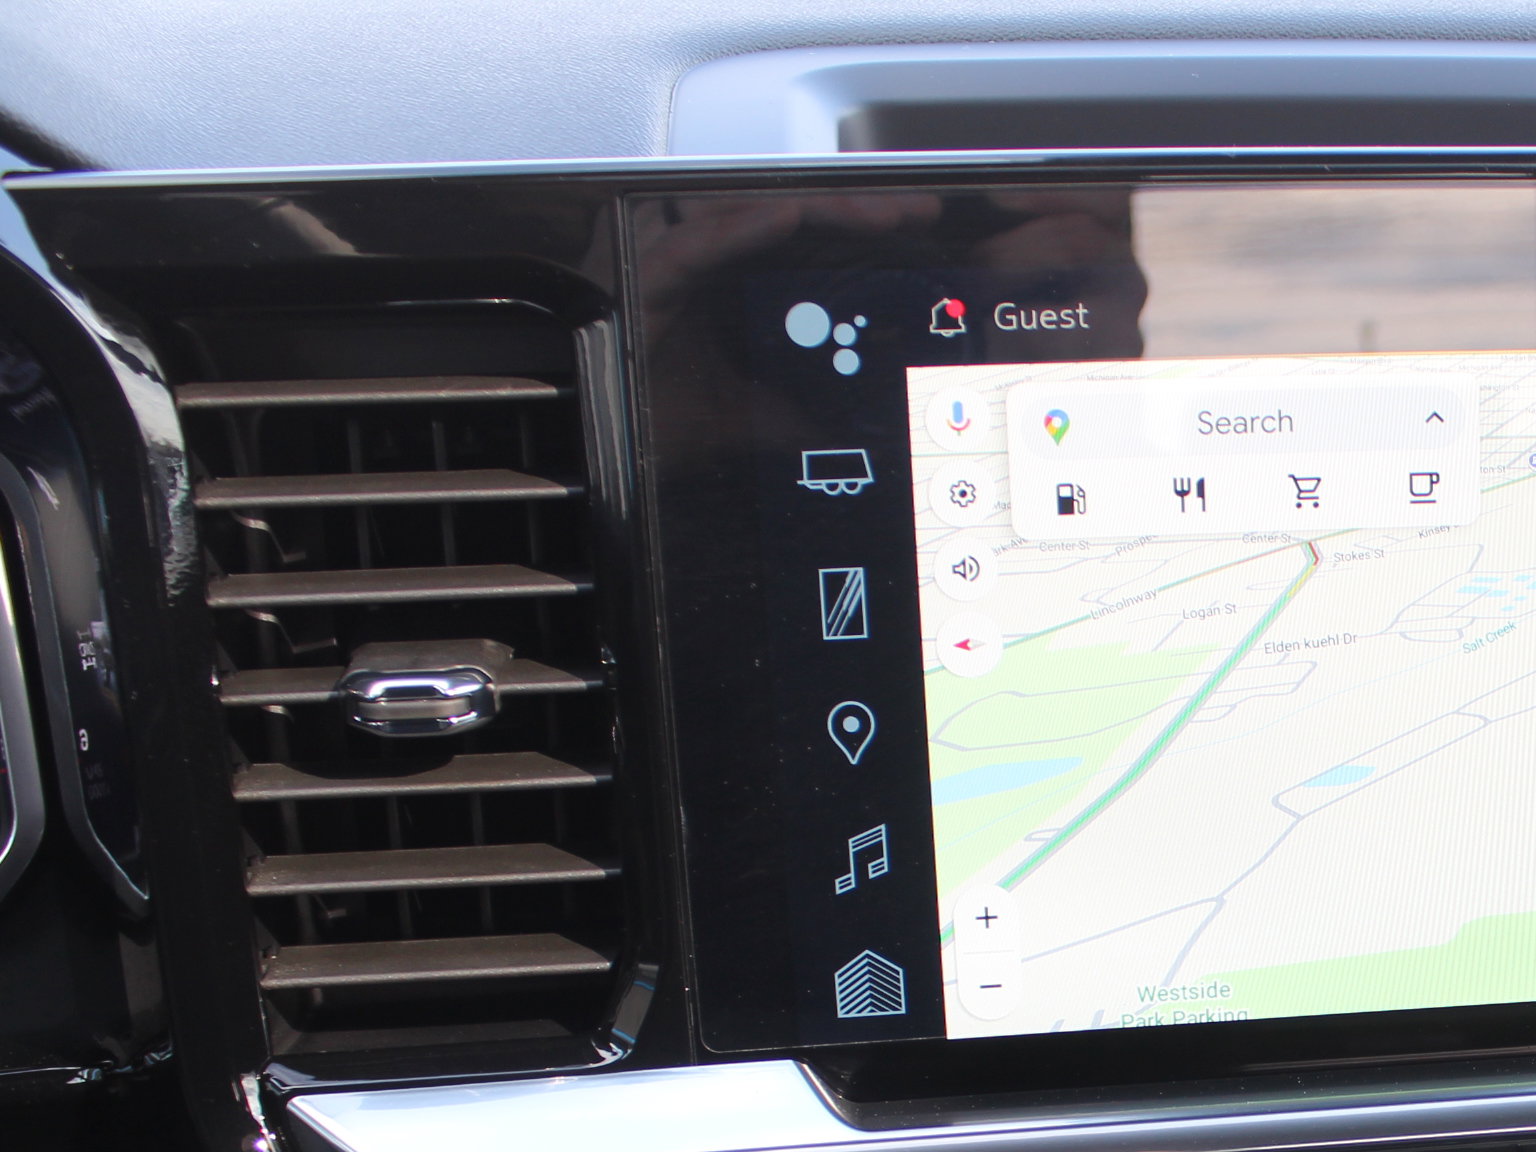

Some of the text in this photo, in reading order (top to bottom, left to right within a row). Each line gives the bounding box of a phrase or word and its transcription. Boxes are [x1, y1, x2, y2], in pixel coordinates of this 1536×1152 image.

[994, 303, 1090, 331] Guest
[1197, 409, 1294, 434] Search
[1242, 533, 1291, 543] Center St
[1418, 525, 1450, 539] Kinsey
[1039, 540, 1090, 551] Center St
[1115, 534, 1157, 556] Prospe
[1333, 549, 1385, 563] Stokes St
[1091, 588, 1159, 620] Lincolnway
[1182, 604, 1237, 622] Logan St
[1264, 633, 1358, 655] Elden kuehl Dr
[1462, 619, 1518, 655] Salt Creek
[1137, 981, 1231, 1003] Westside
[1121, 1008, 1248, 1028] Park Parking
